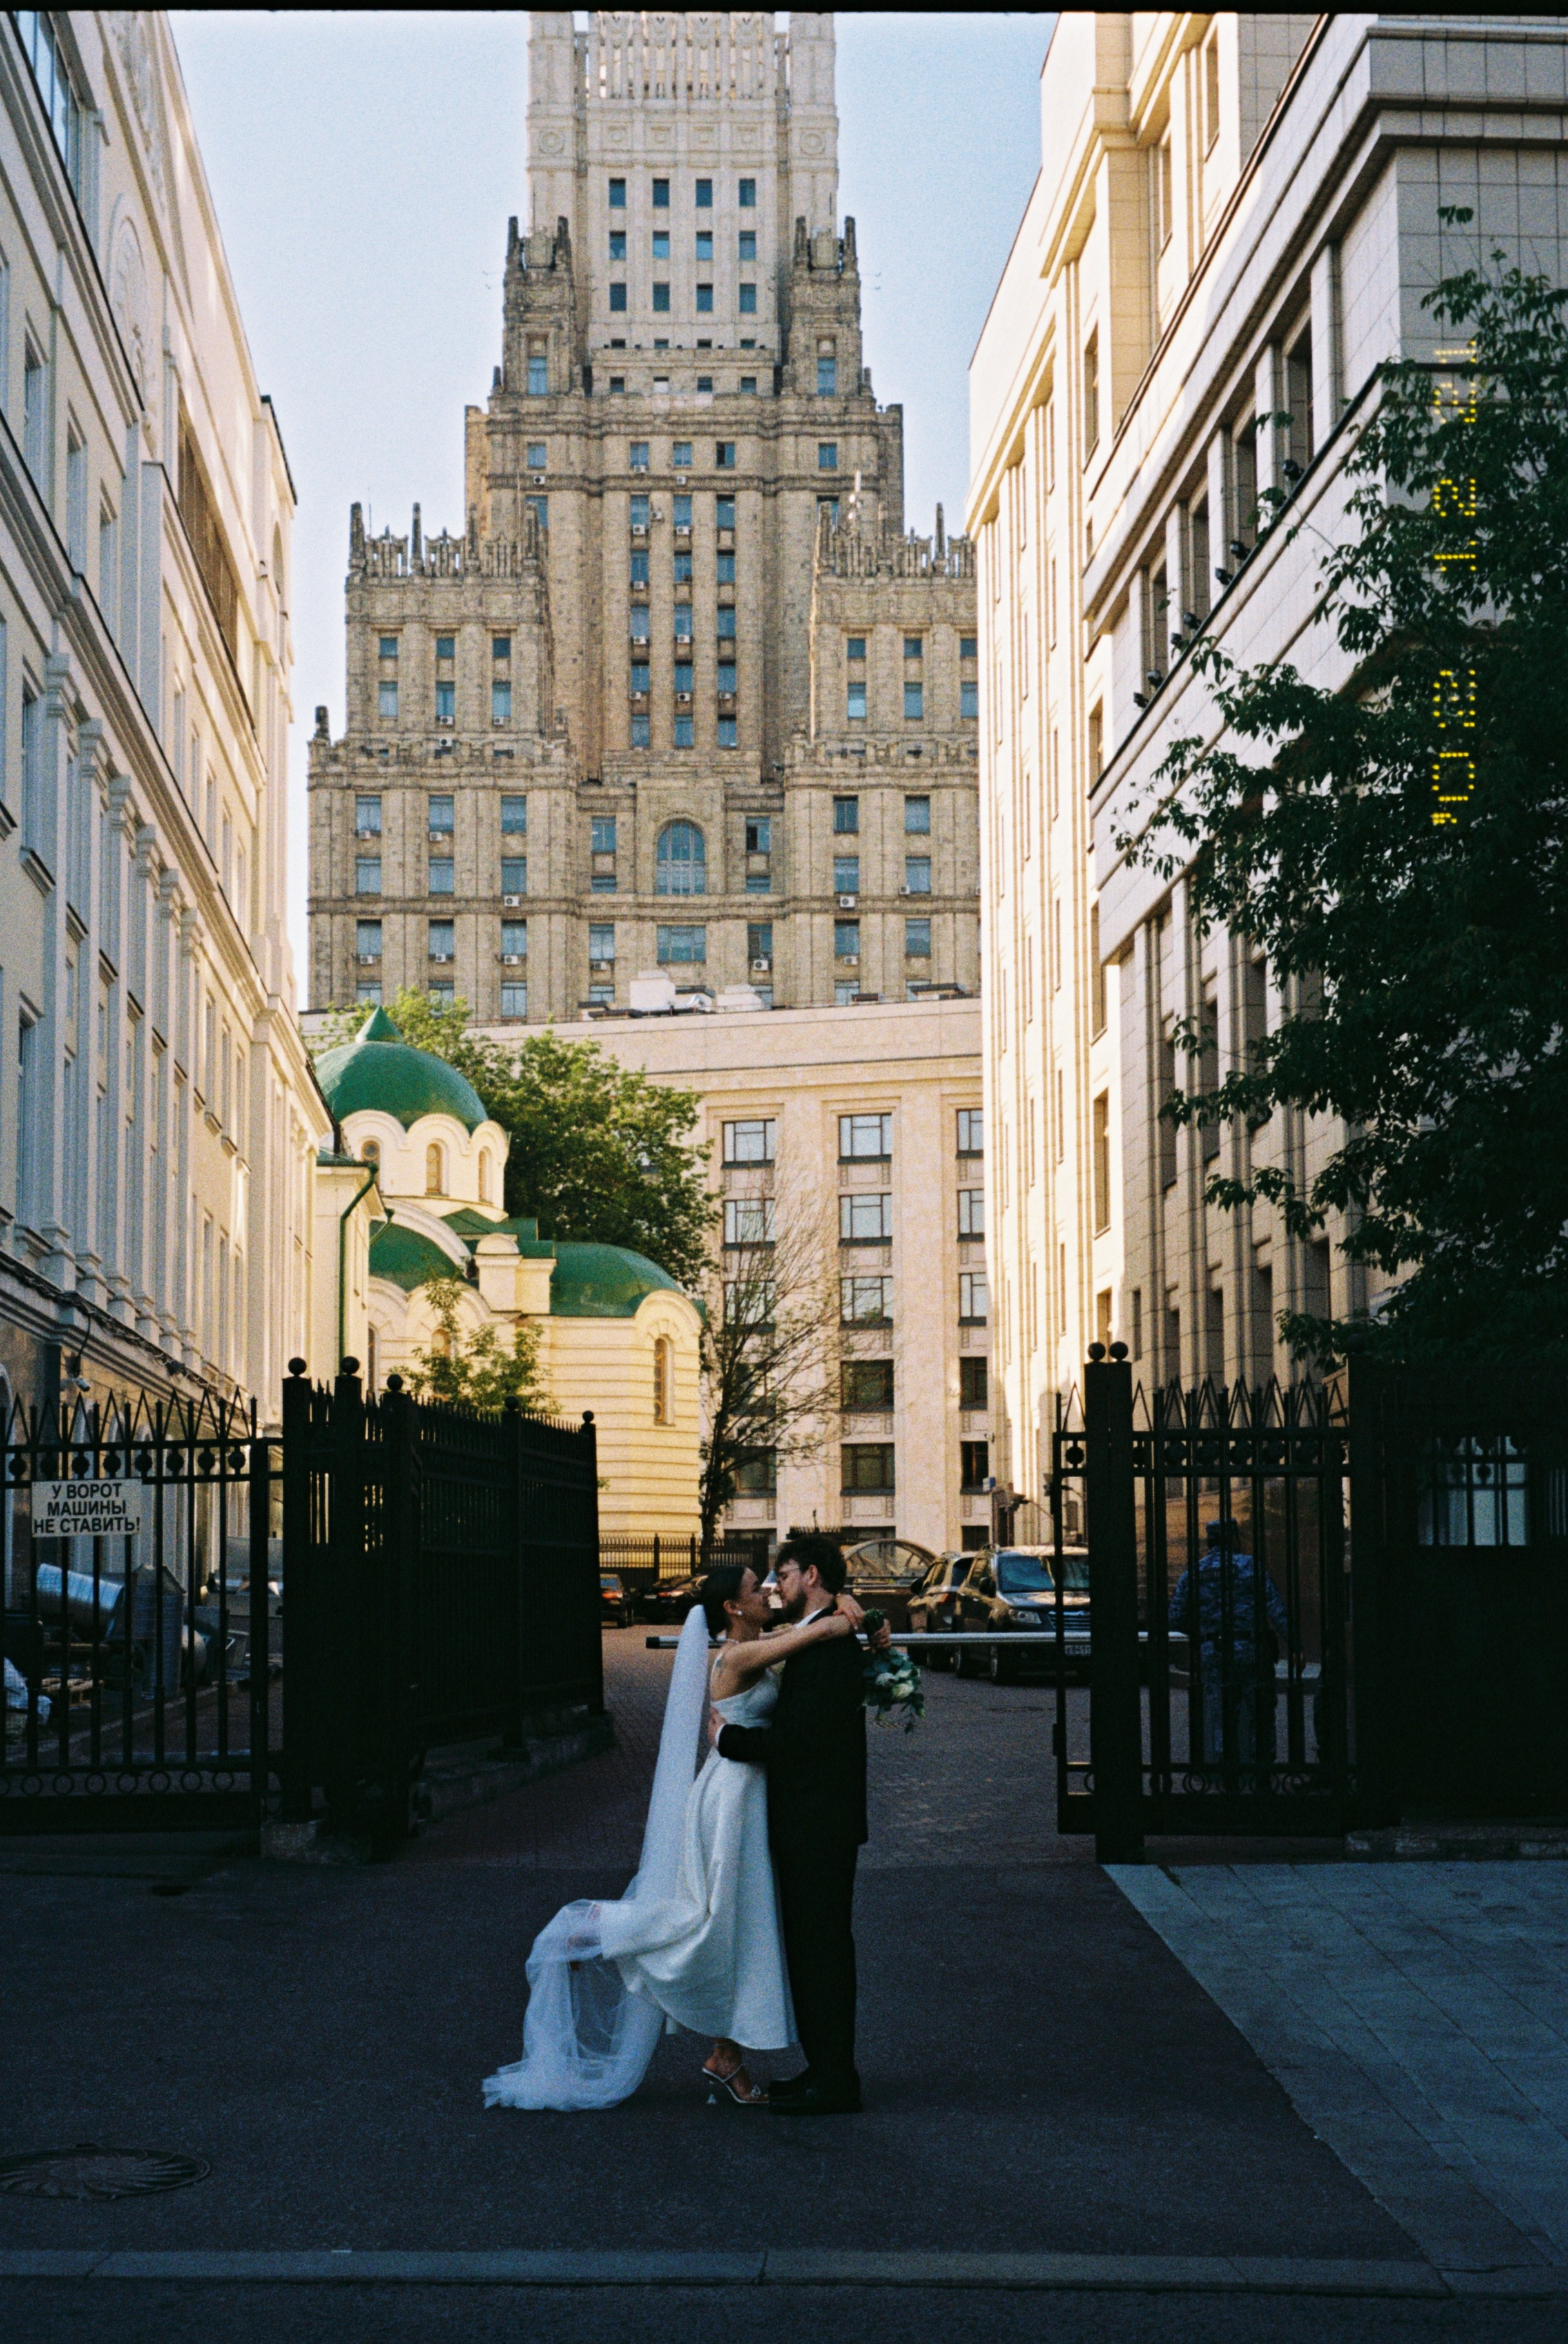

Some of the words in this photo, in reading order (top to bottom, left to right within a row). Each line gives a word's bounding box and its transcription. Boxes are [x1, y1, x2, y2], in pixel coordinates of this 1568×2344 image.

[52, 1484, 62, 1499] У
[66, 1483, 122, 1498] ВОРОТ
[47, 1500, 126, 1516] МАШИНЫ
[34, 1518, 55, 1533] НЕ
[60, 1516, 140, 1533] СТАВИТЬ!
